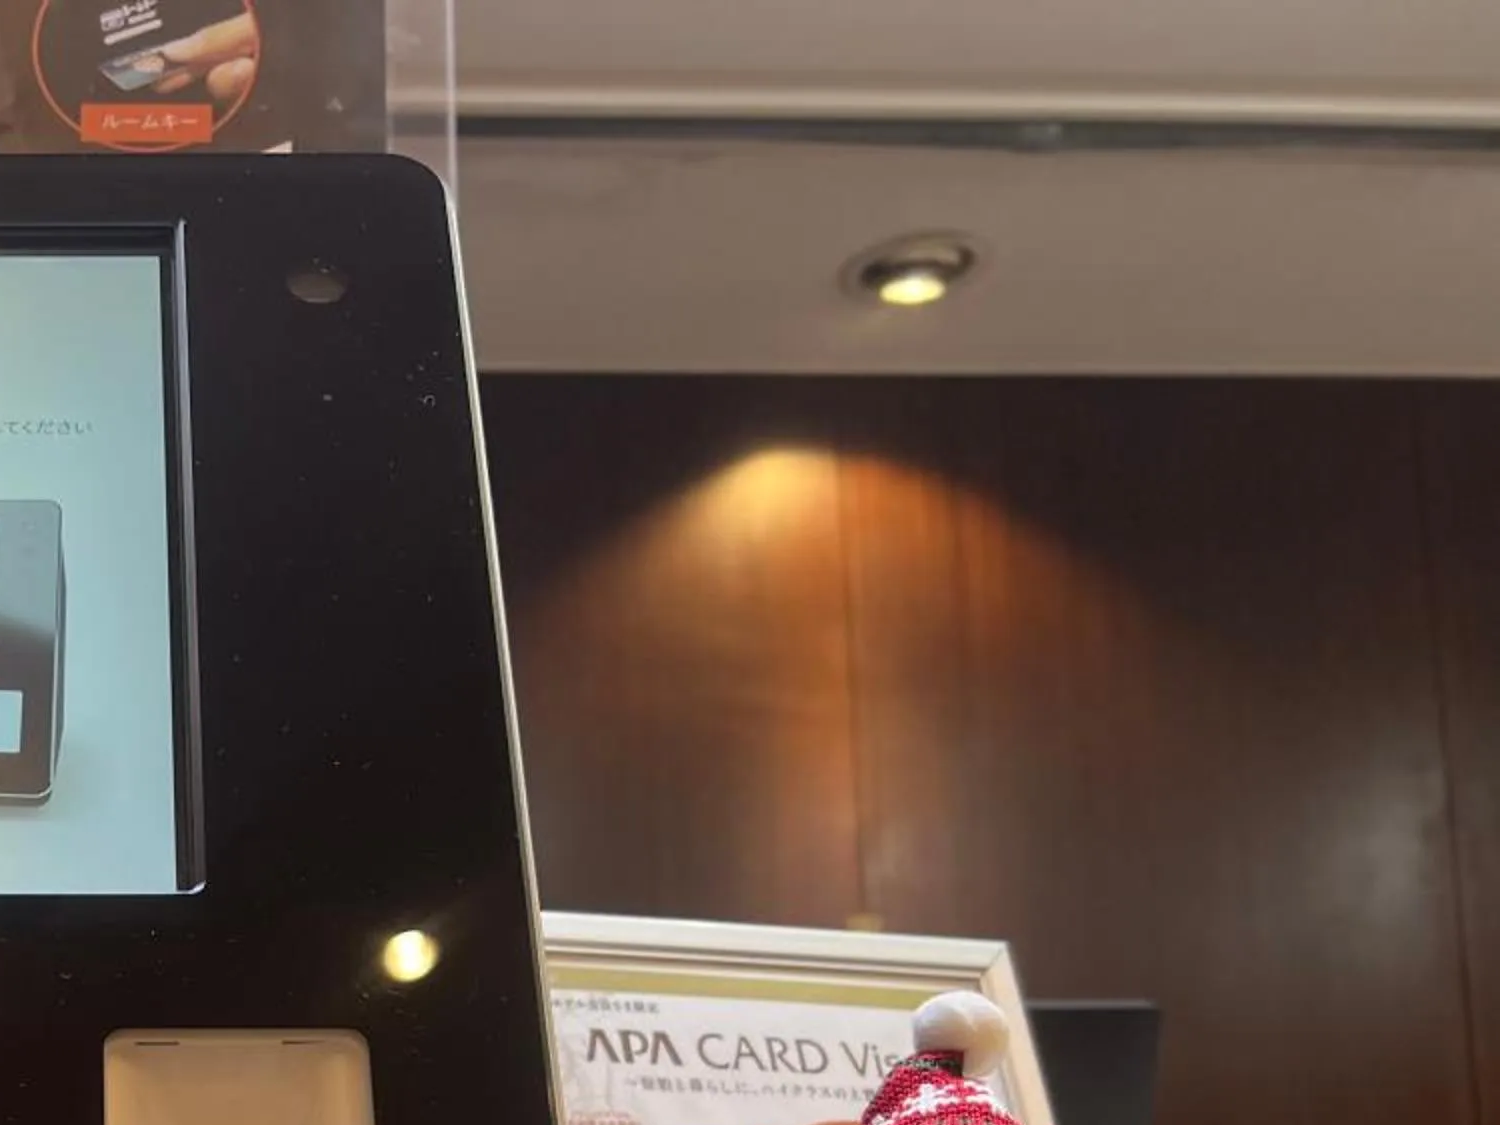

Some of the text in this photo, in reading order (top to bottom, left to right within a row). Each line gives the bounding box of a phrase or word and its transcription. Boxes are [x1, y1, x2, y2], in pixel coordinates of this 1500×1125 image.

[102, 114, 199, 130] ルームキー
[586, 1027, 903, 1079] APA CARD Vis
